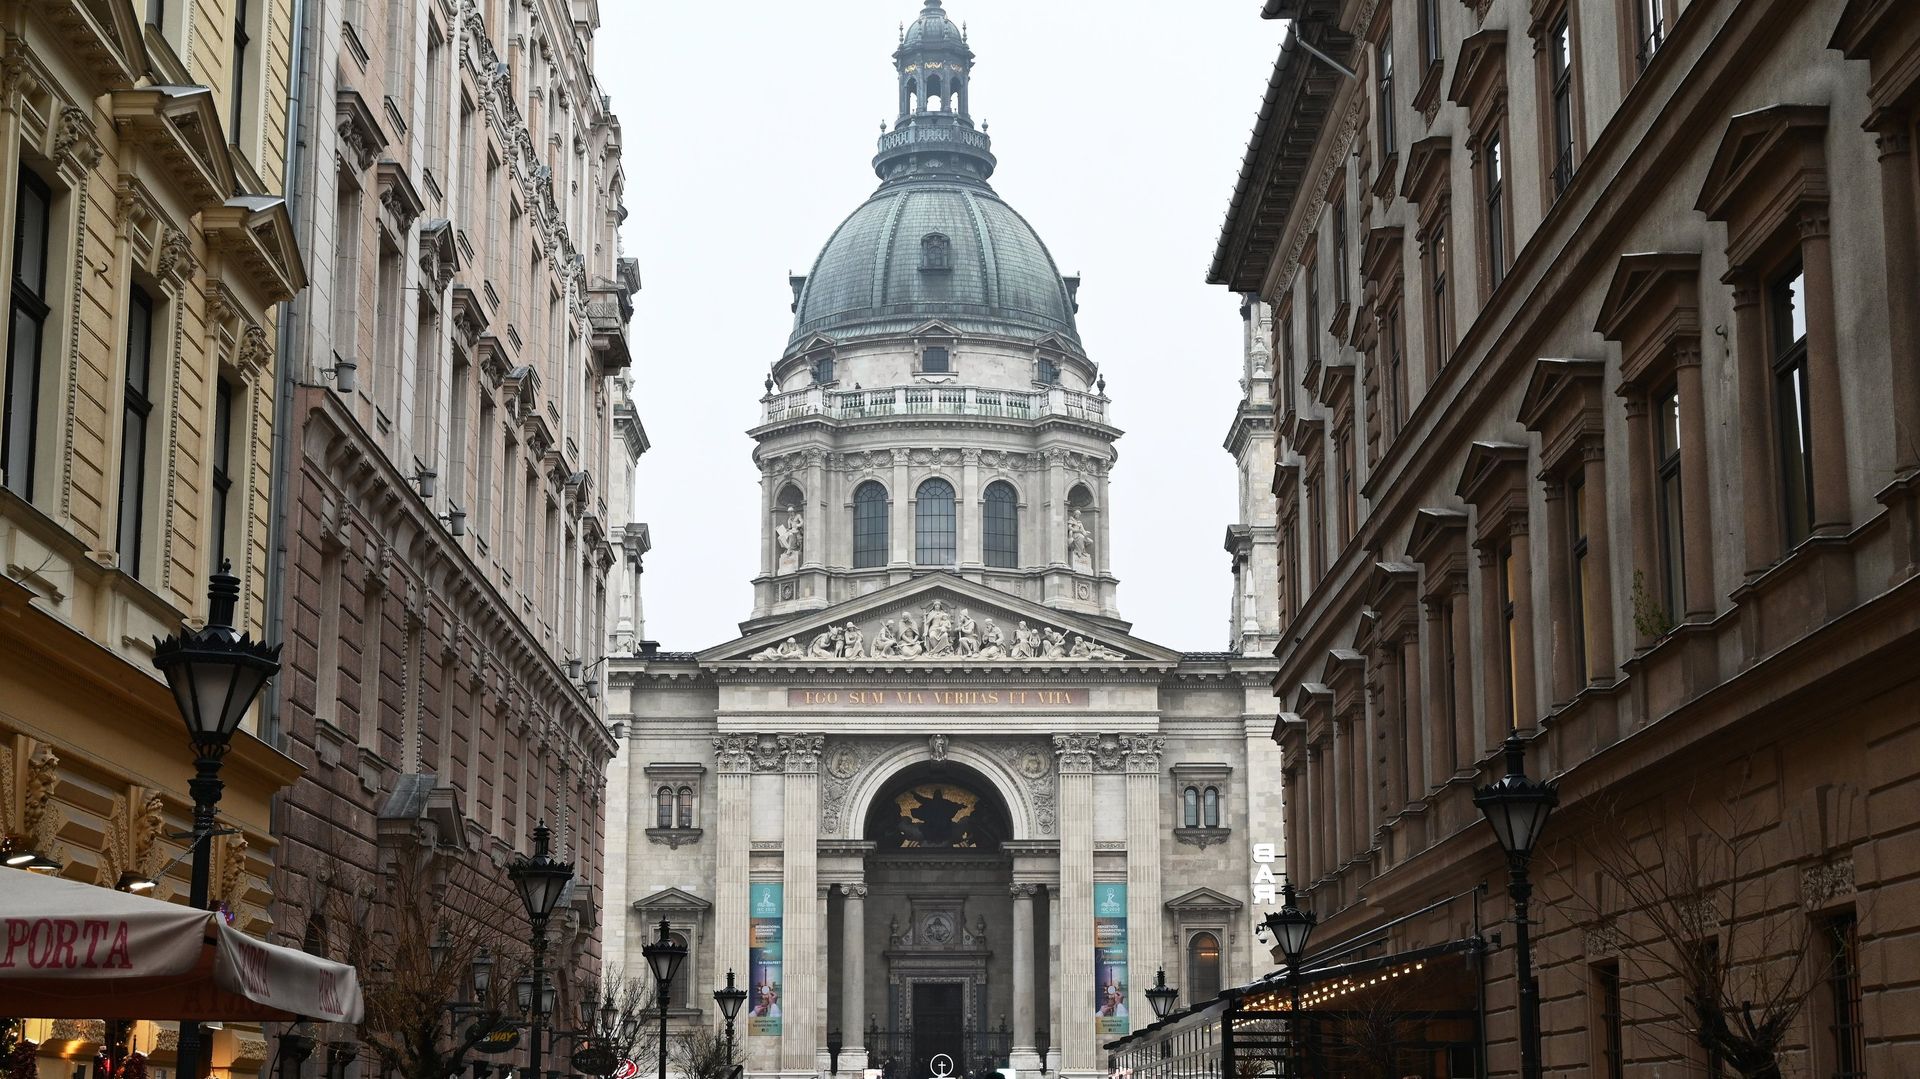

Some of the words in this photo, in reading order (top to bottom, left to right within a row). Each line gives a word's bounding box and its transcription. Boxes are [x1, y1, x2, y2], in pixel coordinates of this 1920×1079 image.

[804, 691, 838, 704] EGO
[849, 691, 884, 704] SUM
[896, 691, 924, 704] VIA
[934, 691, 999, 704] VERITAS
[1008, 691, 1028, 704] ET
[1038, 691, 1072, 704] VITA
[0, 918, 133, 969] PORTA
